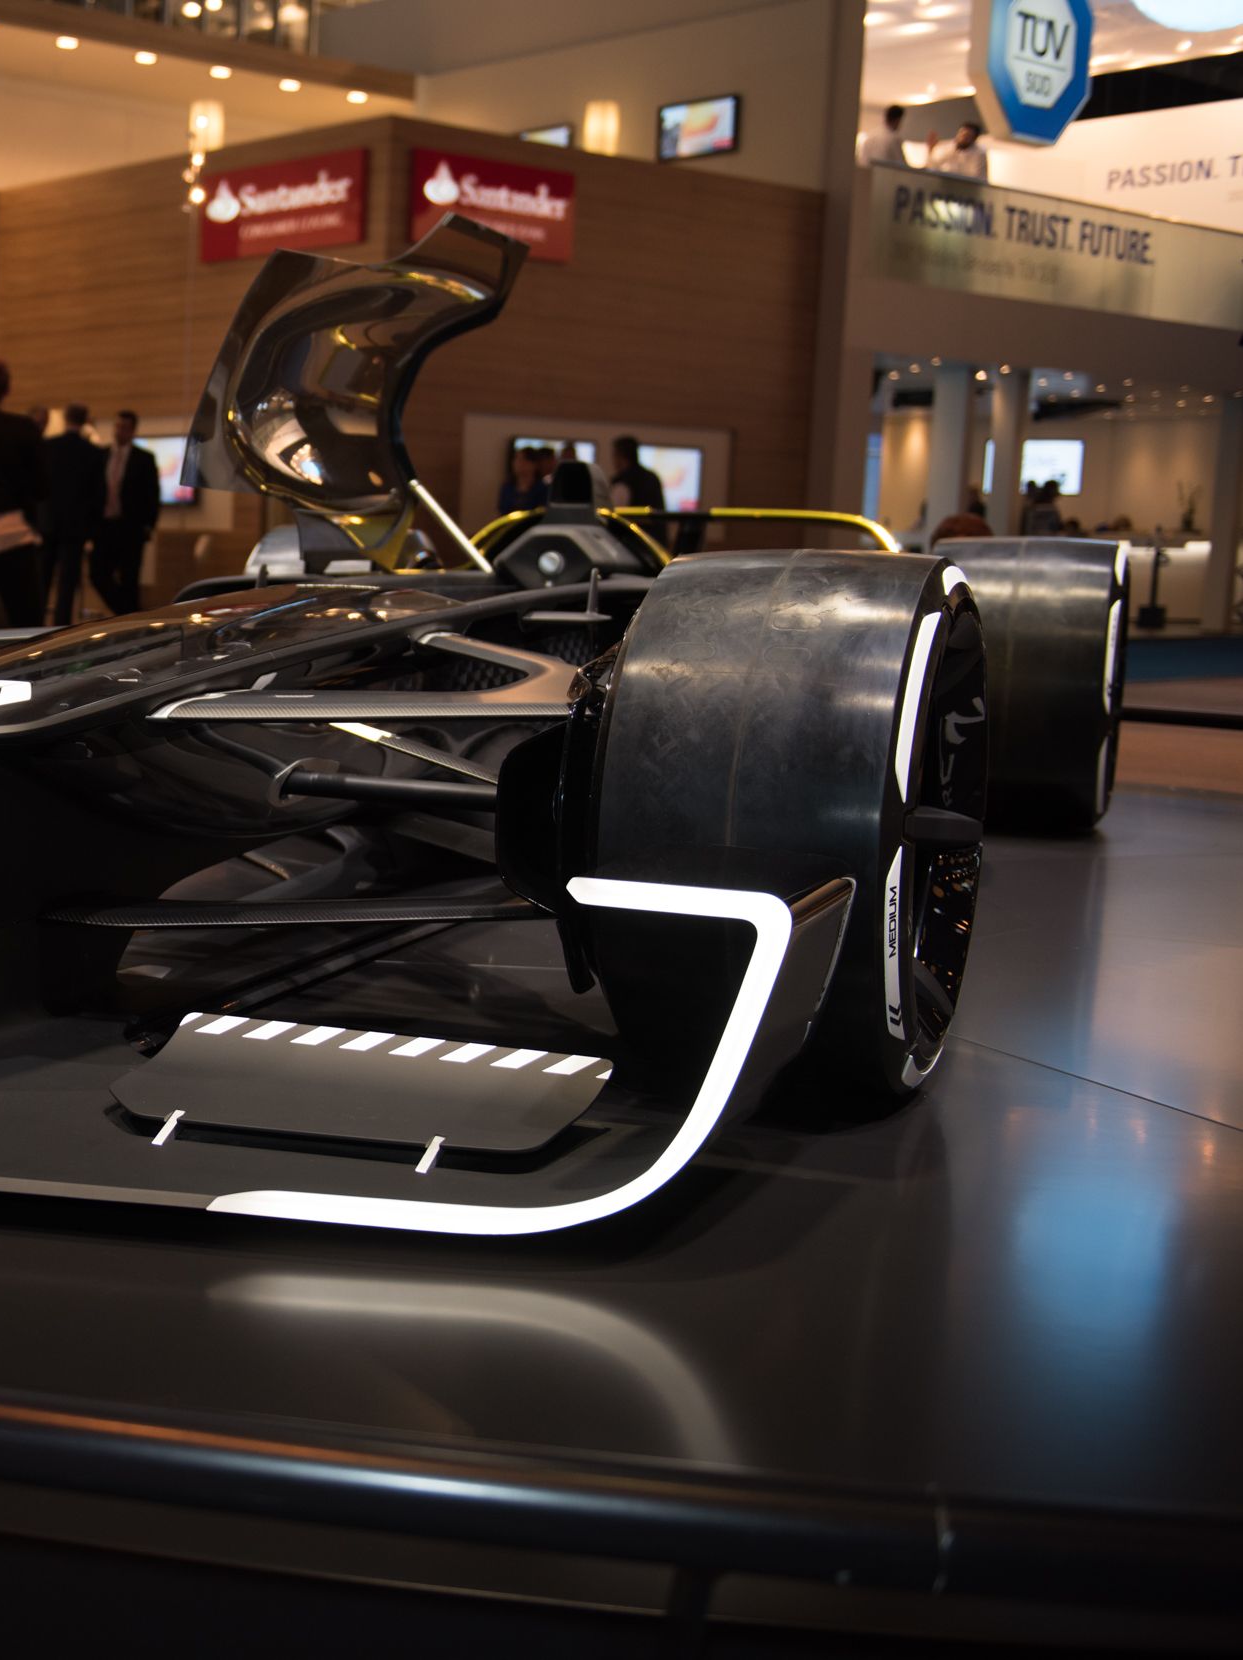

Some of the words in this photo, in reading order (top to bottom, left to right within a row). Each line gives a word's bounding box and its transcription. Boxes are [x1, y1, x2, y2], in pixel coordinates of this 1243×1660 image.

[1016, 9, 1070, 61] TÜV
[239, 169, 352, 216] Santander
[459, 173, 568, 221] Santander
[888, 886, 898, 959] MEDIUM
